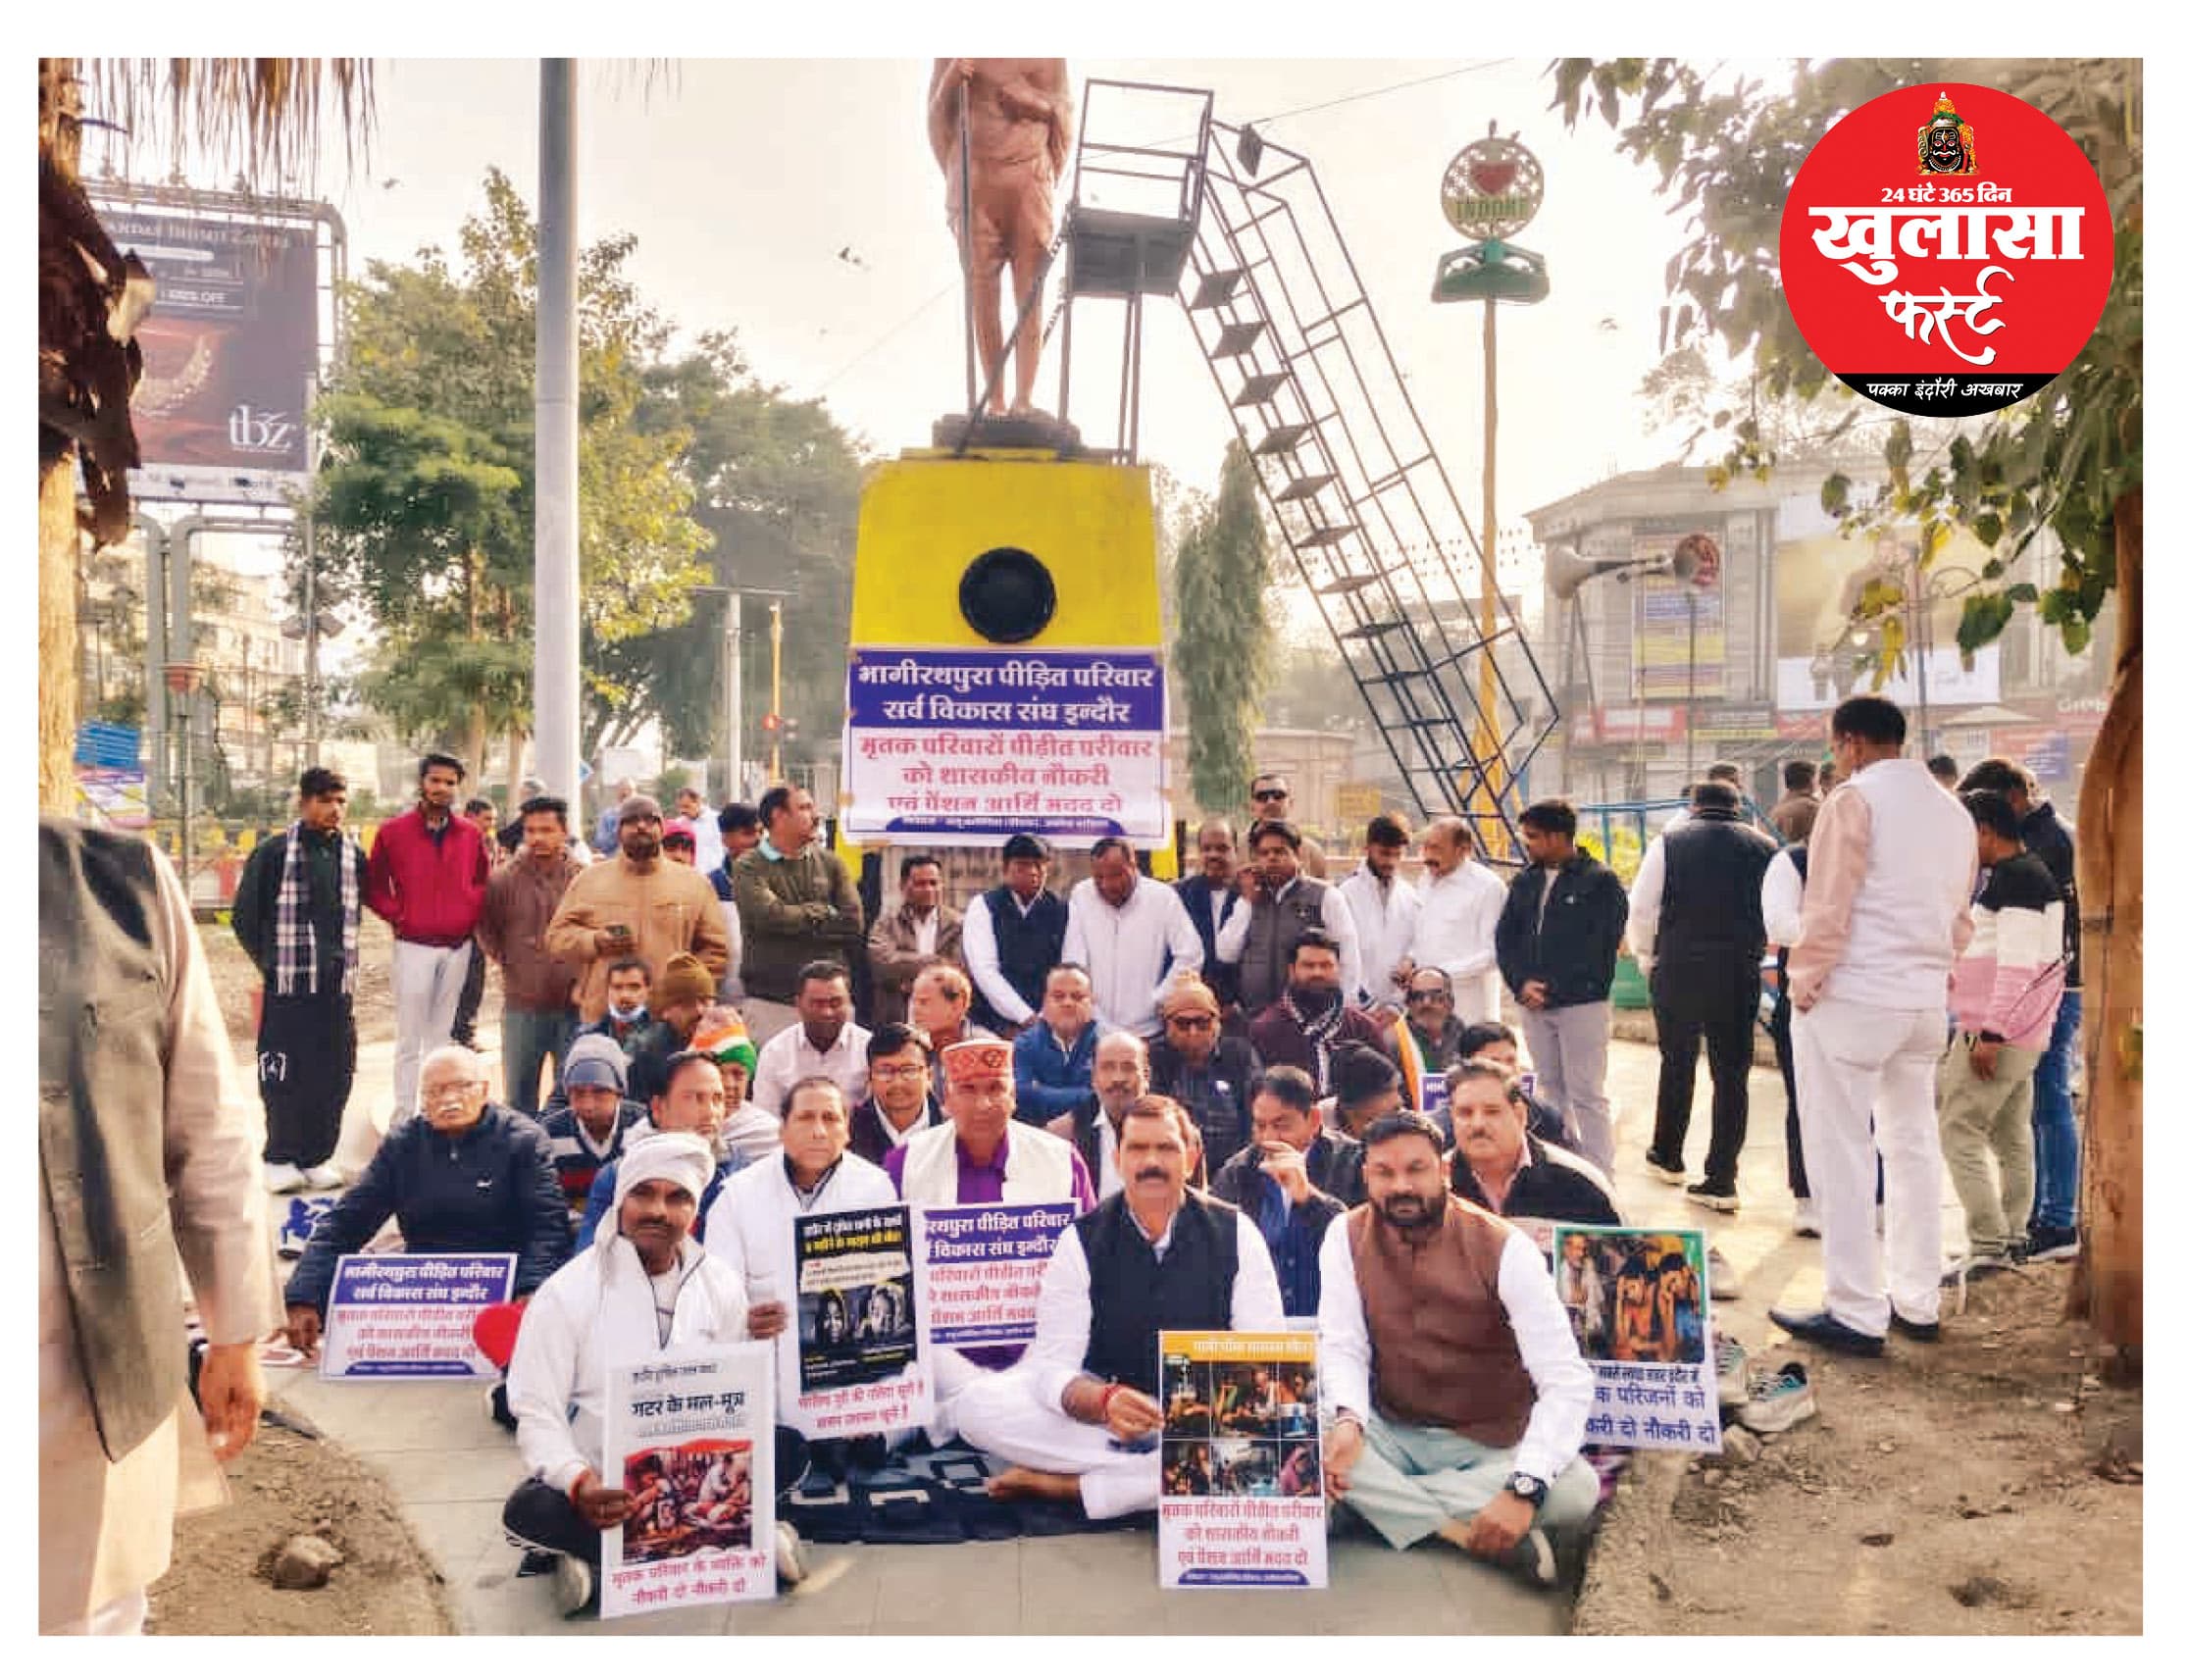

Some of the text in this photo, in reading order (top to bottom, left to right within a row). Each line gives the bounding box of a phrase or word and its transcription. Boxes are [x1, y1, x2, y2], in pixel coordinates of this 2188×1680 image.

[229, 404, 292, 448] tbz
[858, 658, 1154, 691] भागीरथपुरा पीड़ित परिवार
[883, 693, 925, 721] सर्व
[931, 694, 1012, 722] विकास
[1017, 695, 1057, 723] संघ
[859, 737, 917, 761] मृतक
[922, 732, 1004, 758] परिवारों
[902, 760, 1110, 786] को शासकीय नौकरी
[1098, 792, 1122, 813] दो
[926, 1218, 974, 1239] रथपुरा
[935, 1240, 986, 1258] विकास
[631, 1400, 664, 1418] गटर
[666, 1394, 683, 1413] के
[1683, 1385, 1705, 1409] को
[1586, 1412, 1716, 1445] करी दो नौकरी दो
